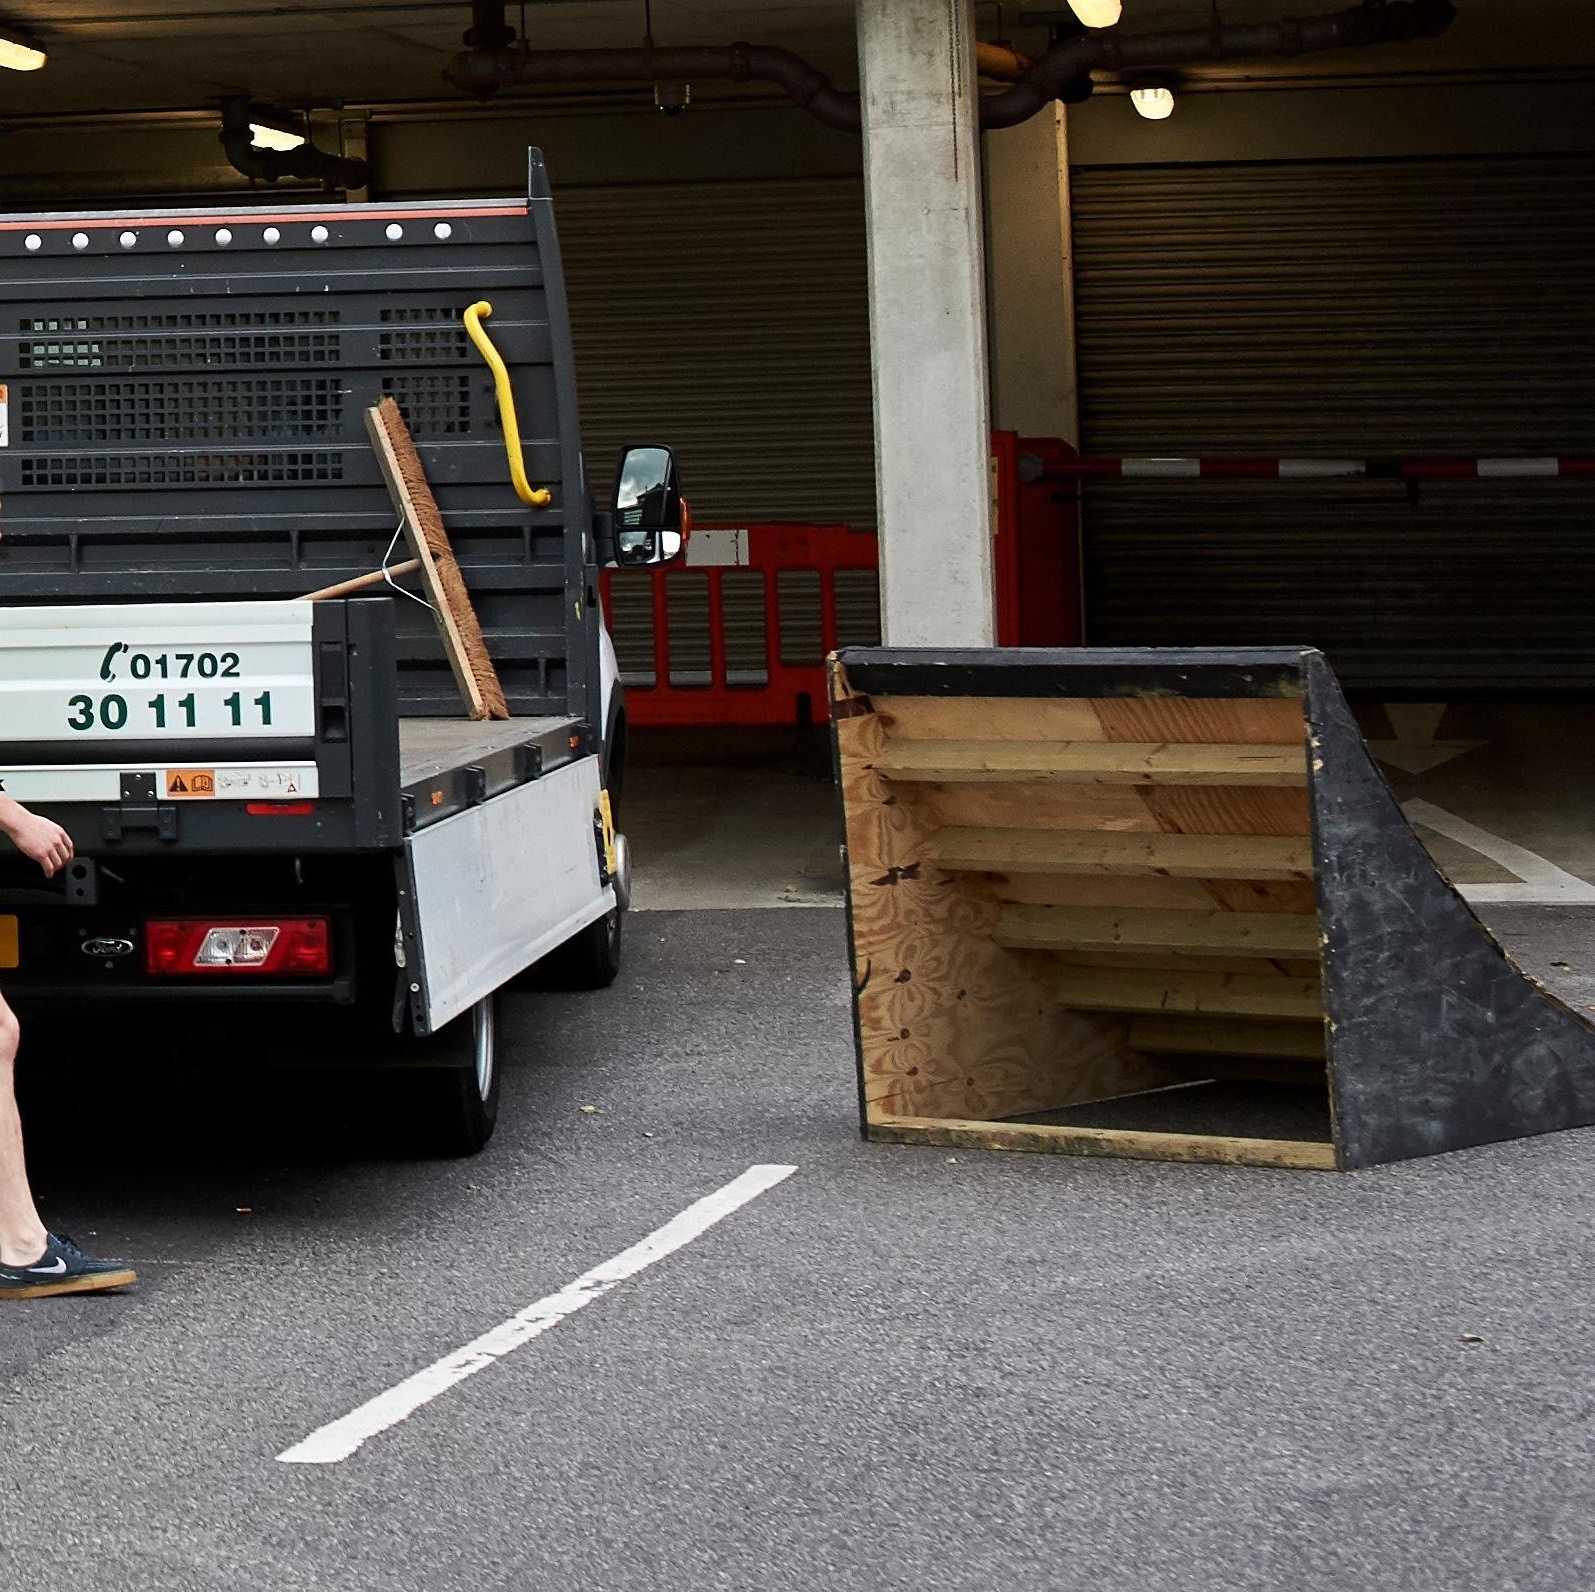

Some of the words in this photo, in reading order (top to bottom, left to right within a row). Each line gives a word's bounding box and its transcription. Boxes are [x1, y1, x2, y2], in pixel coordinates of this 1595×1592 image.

[130, 652, 240, 679] 01702
[67, 693, 128, 731] 30
[148, 692, 196, 728] 11
[223, 690, 272, 726] 11
